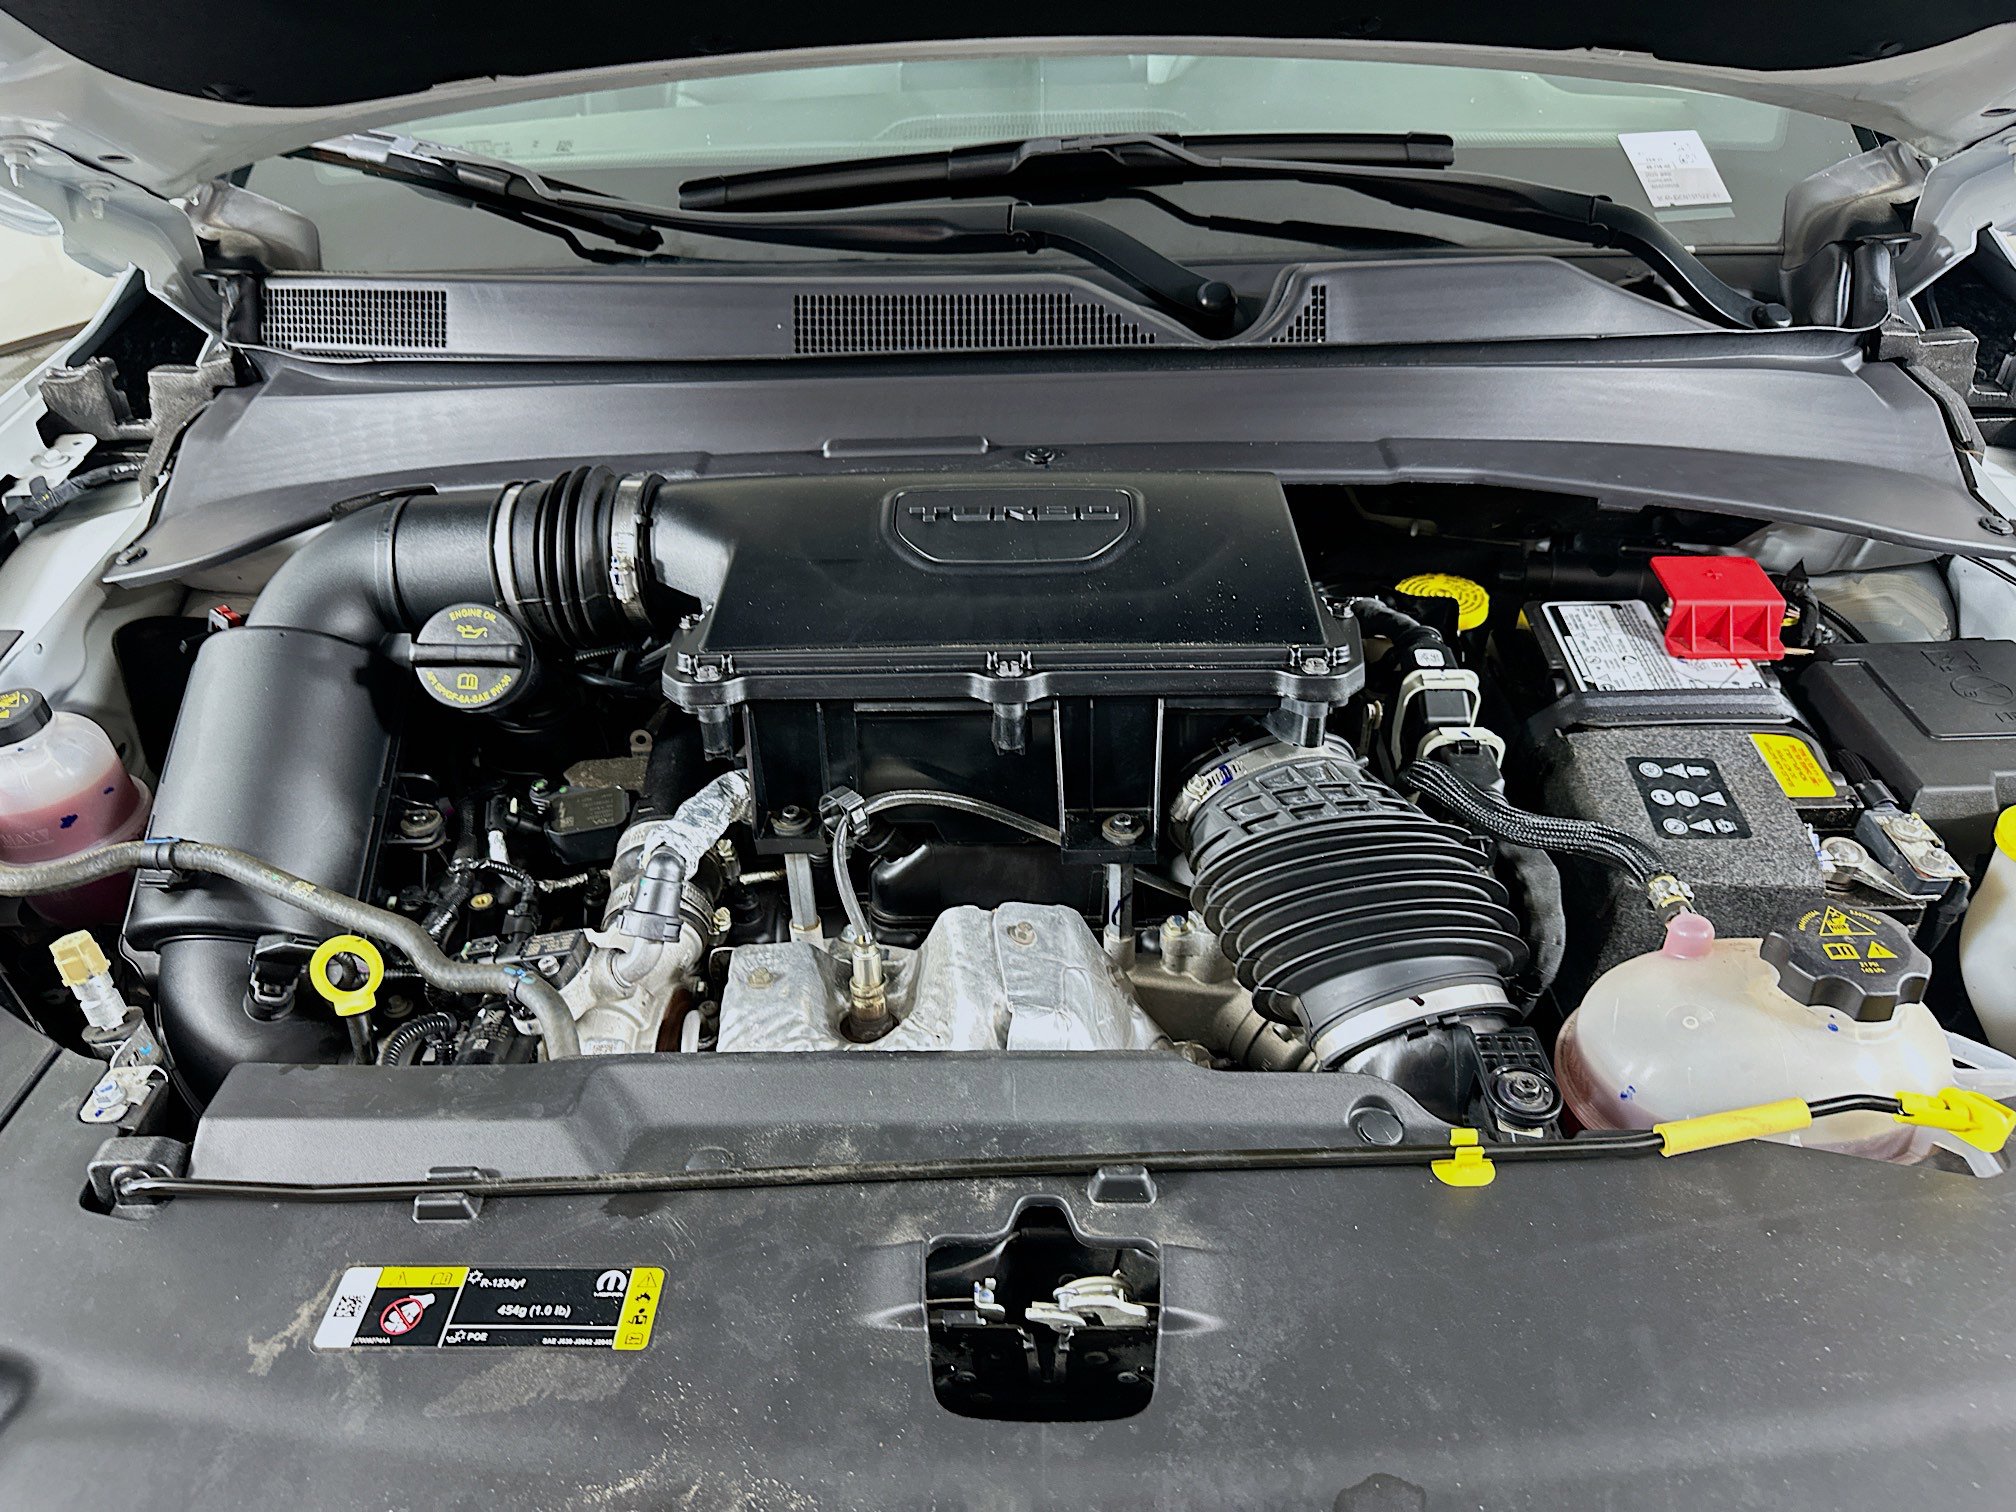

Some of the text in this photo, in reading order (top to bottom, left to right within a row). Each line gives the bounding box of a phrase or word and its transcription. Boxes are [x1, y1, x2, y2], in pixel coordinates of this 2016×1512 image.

[909, 505, 1119, 523] TURBO
[449, 608, 496, 623] ENGINE OIL
[480, 1277, 527, 1290] R-1234yf
[497, 1304, 571, 1319] 454g (1.0 lb)
[466, 1331, 489, 1342] POE
